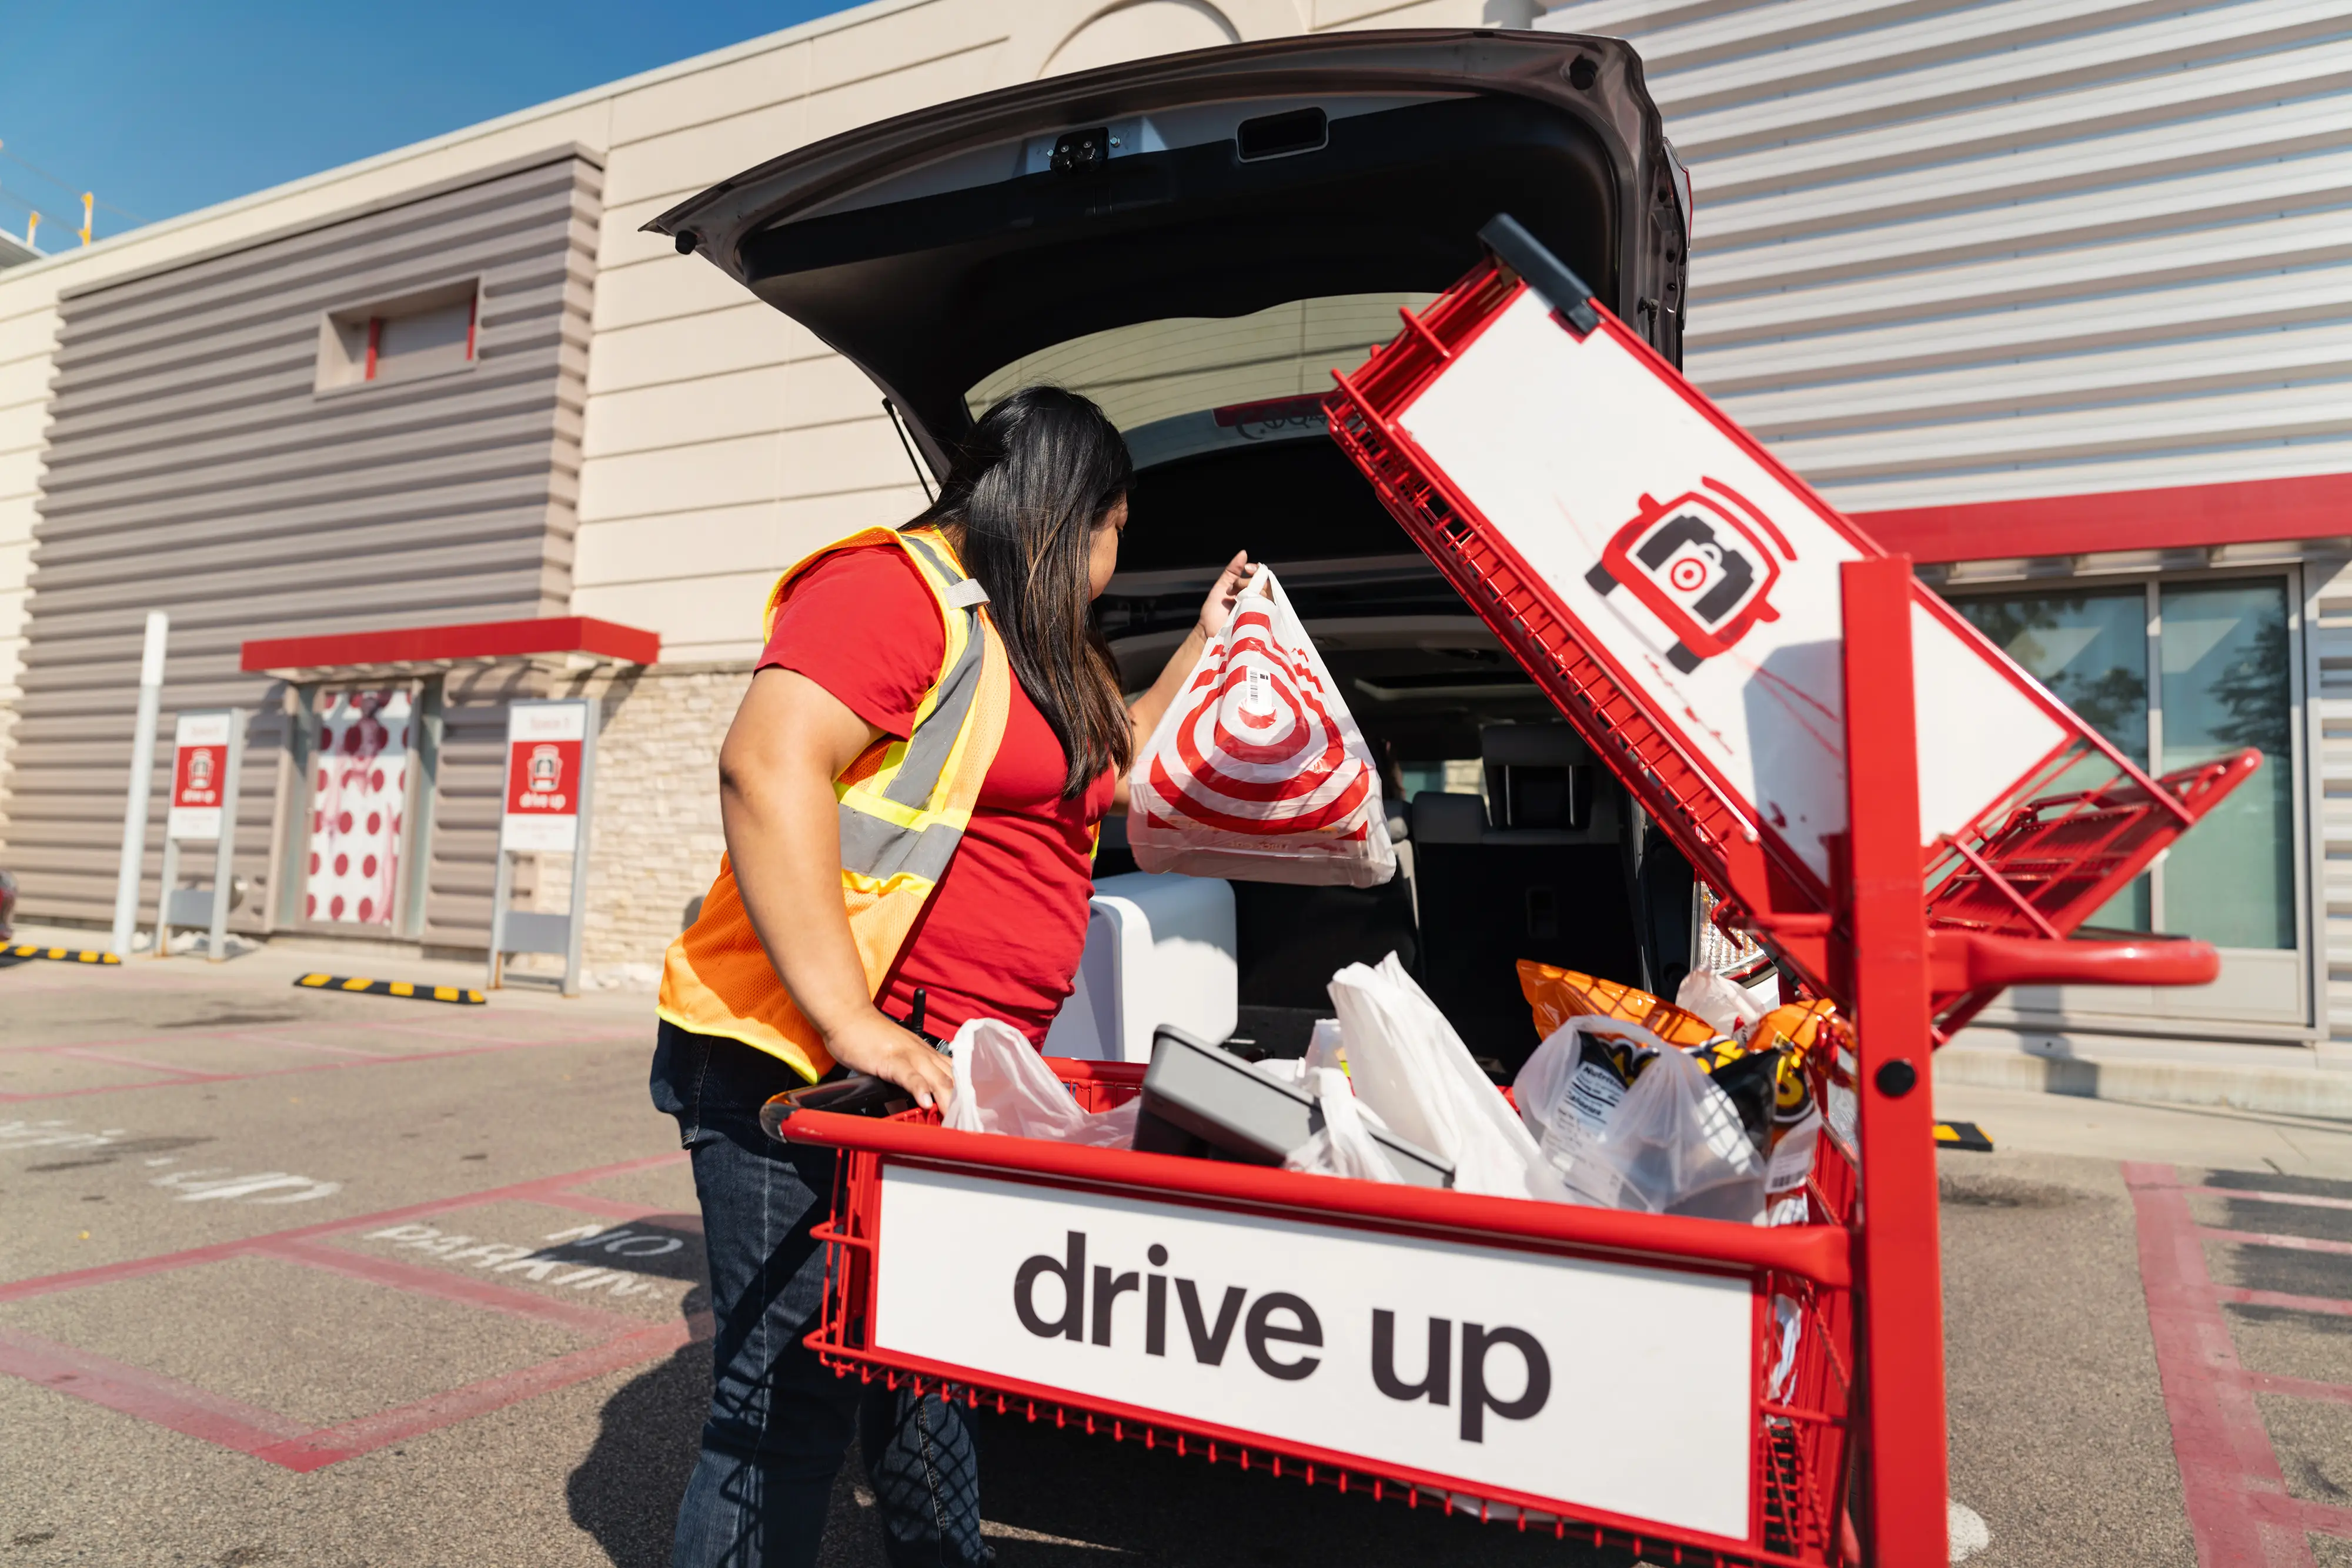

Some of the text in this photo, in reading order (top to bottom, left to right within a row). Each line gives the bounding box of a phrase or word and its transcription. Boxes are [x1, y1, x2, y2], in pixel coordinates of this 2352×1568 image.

[519, 791, 566, 811] drive up
[363, 1224, 663, 1298] PARKIN
[546, 1225, 684, 1256] NO
[1014, 1230, 1551, 1444] drive up
